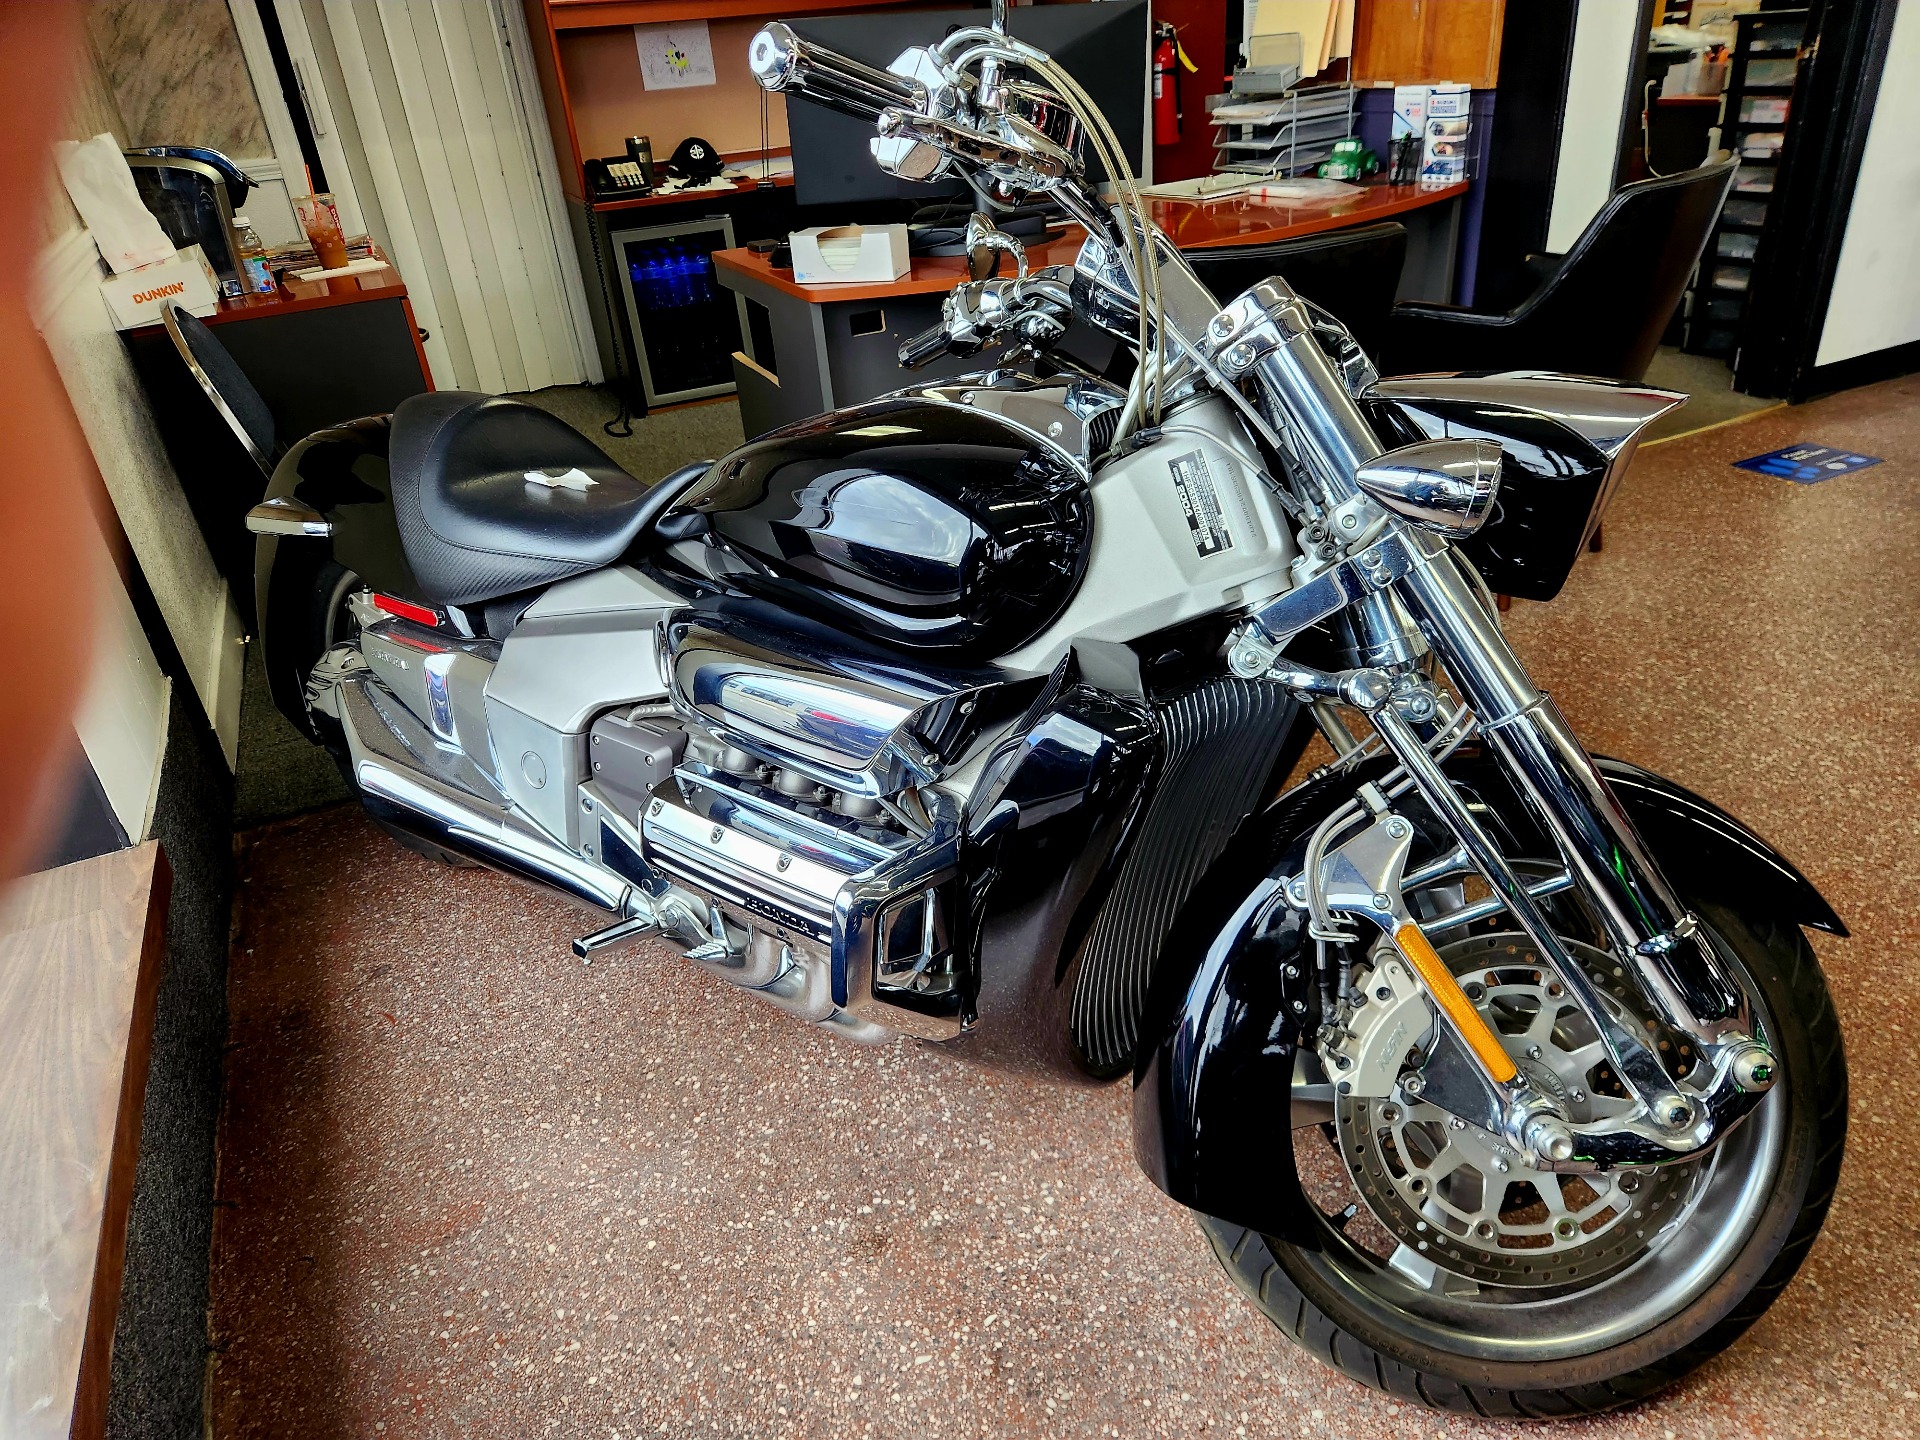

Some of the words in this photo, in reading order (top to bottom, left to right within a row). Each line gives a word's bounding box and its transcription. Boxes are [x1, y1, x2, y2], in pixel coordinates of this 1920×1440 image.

[132, 281, 184, 304] DUNKIN'
[1176, 484, 1194, 518] 2004
[746, 897, 815, 936] HONDA
